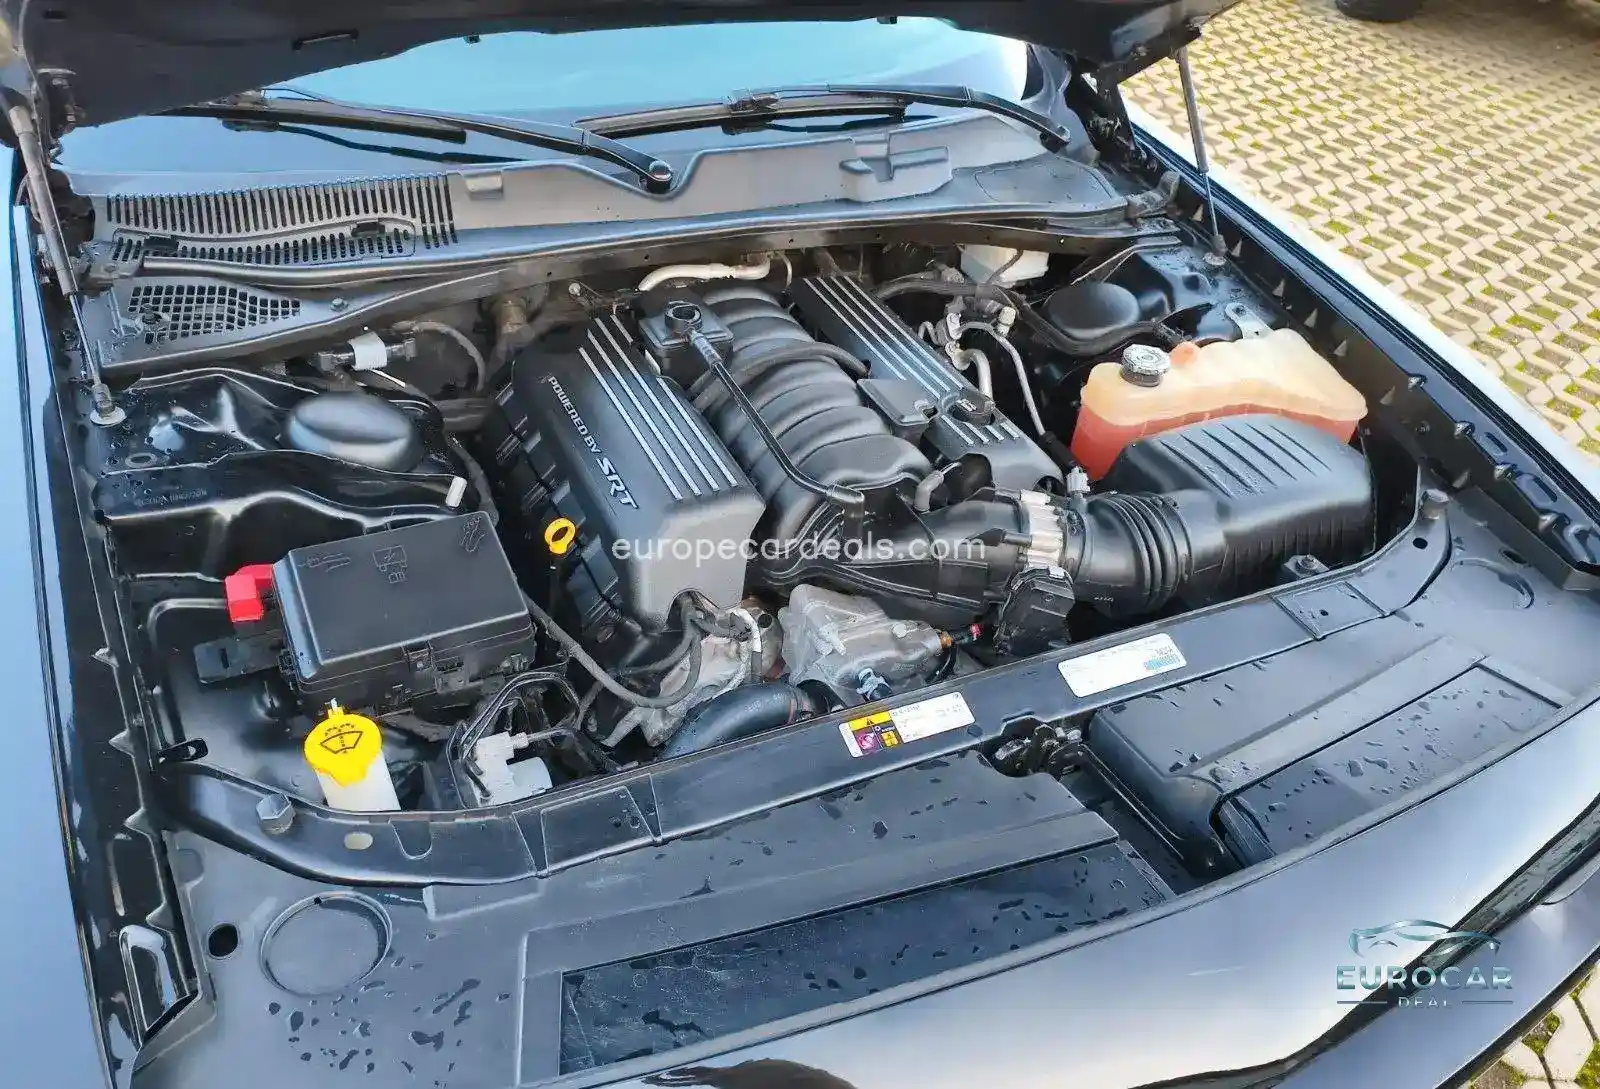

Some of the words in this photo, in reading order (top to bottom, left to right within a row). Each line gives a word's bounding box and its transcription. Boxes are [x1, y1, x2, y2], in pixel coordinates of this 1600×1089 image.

[548, 375, 590, 436] POWERED
[584, 435, 602, 454] BY
[596, 457, 640, 510] SRT
